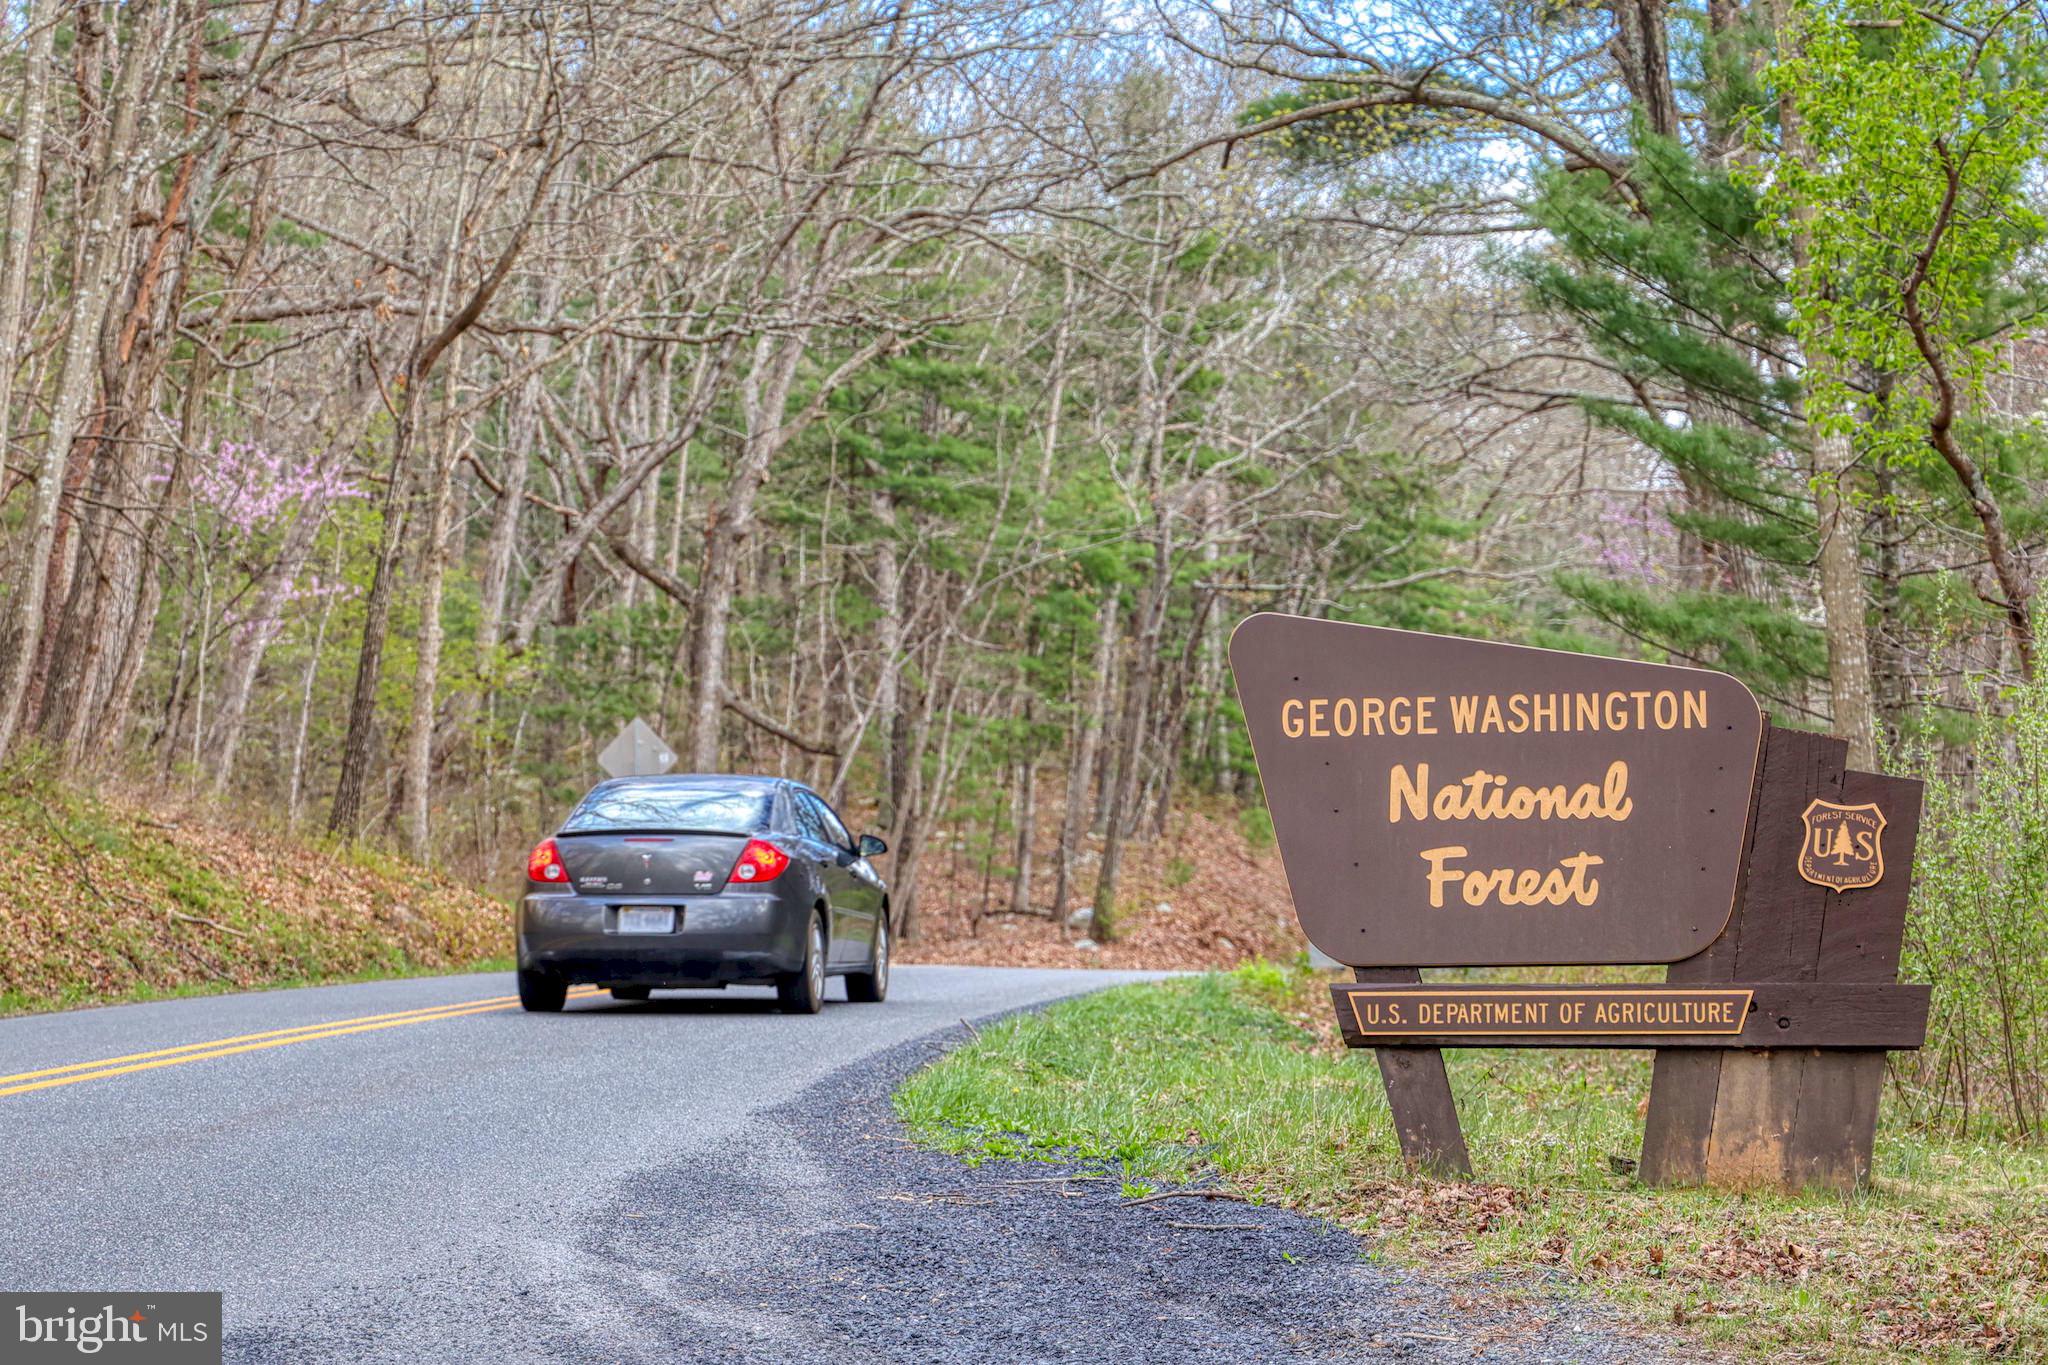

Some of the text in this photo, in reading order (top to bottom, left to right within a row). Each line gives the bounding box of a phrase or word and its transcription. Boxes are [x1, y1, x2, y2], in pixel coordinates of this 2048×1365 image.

[1281, 689, 1708, 738] GEORGE WASHINGTON
[1388, 759, 1633, 823] National
[1811, 811, 1877, 829] FOREST SERVICE
[1419, 845, 1605, 908] Forest
[1366, 1001, 1735, 1025] U.S. DEPARTMENT OF AGRICULTURE
